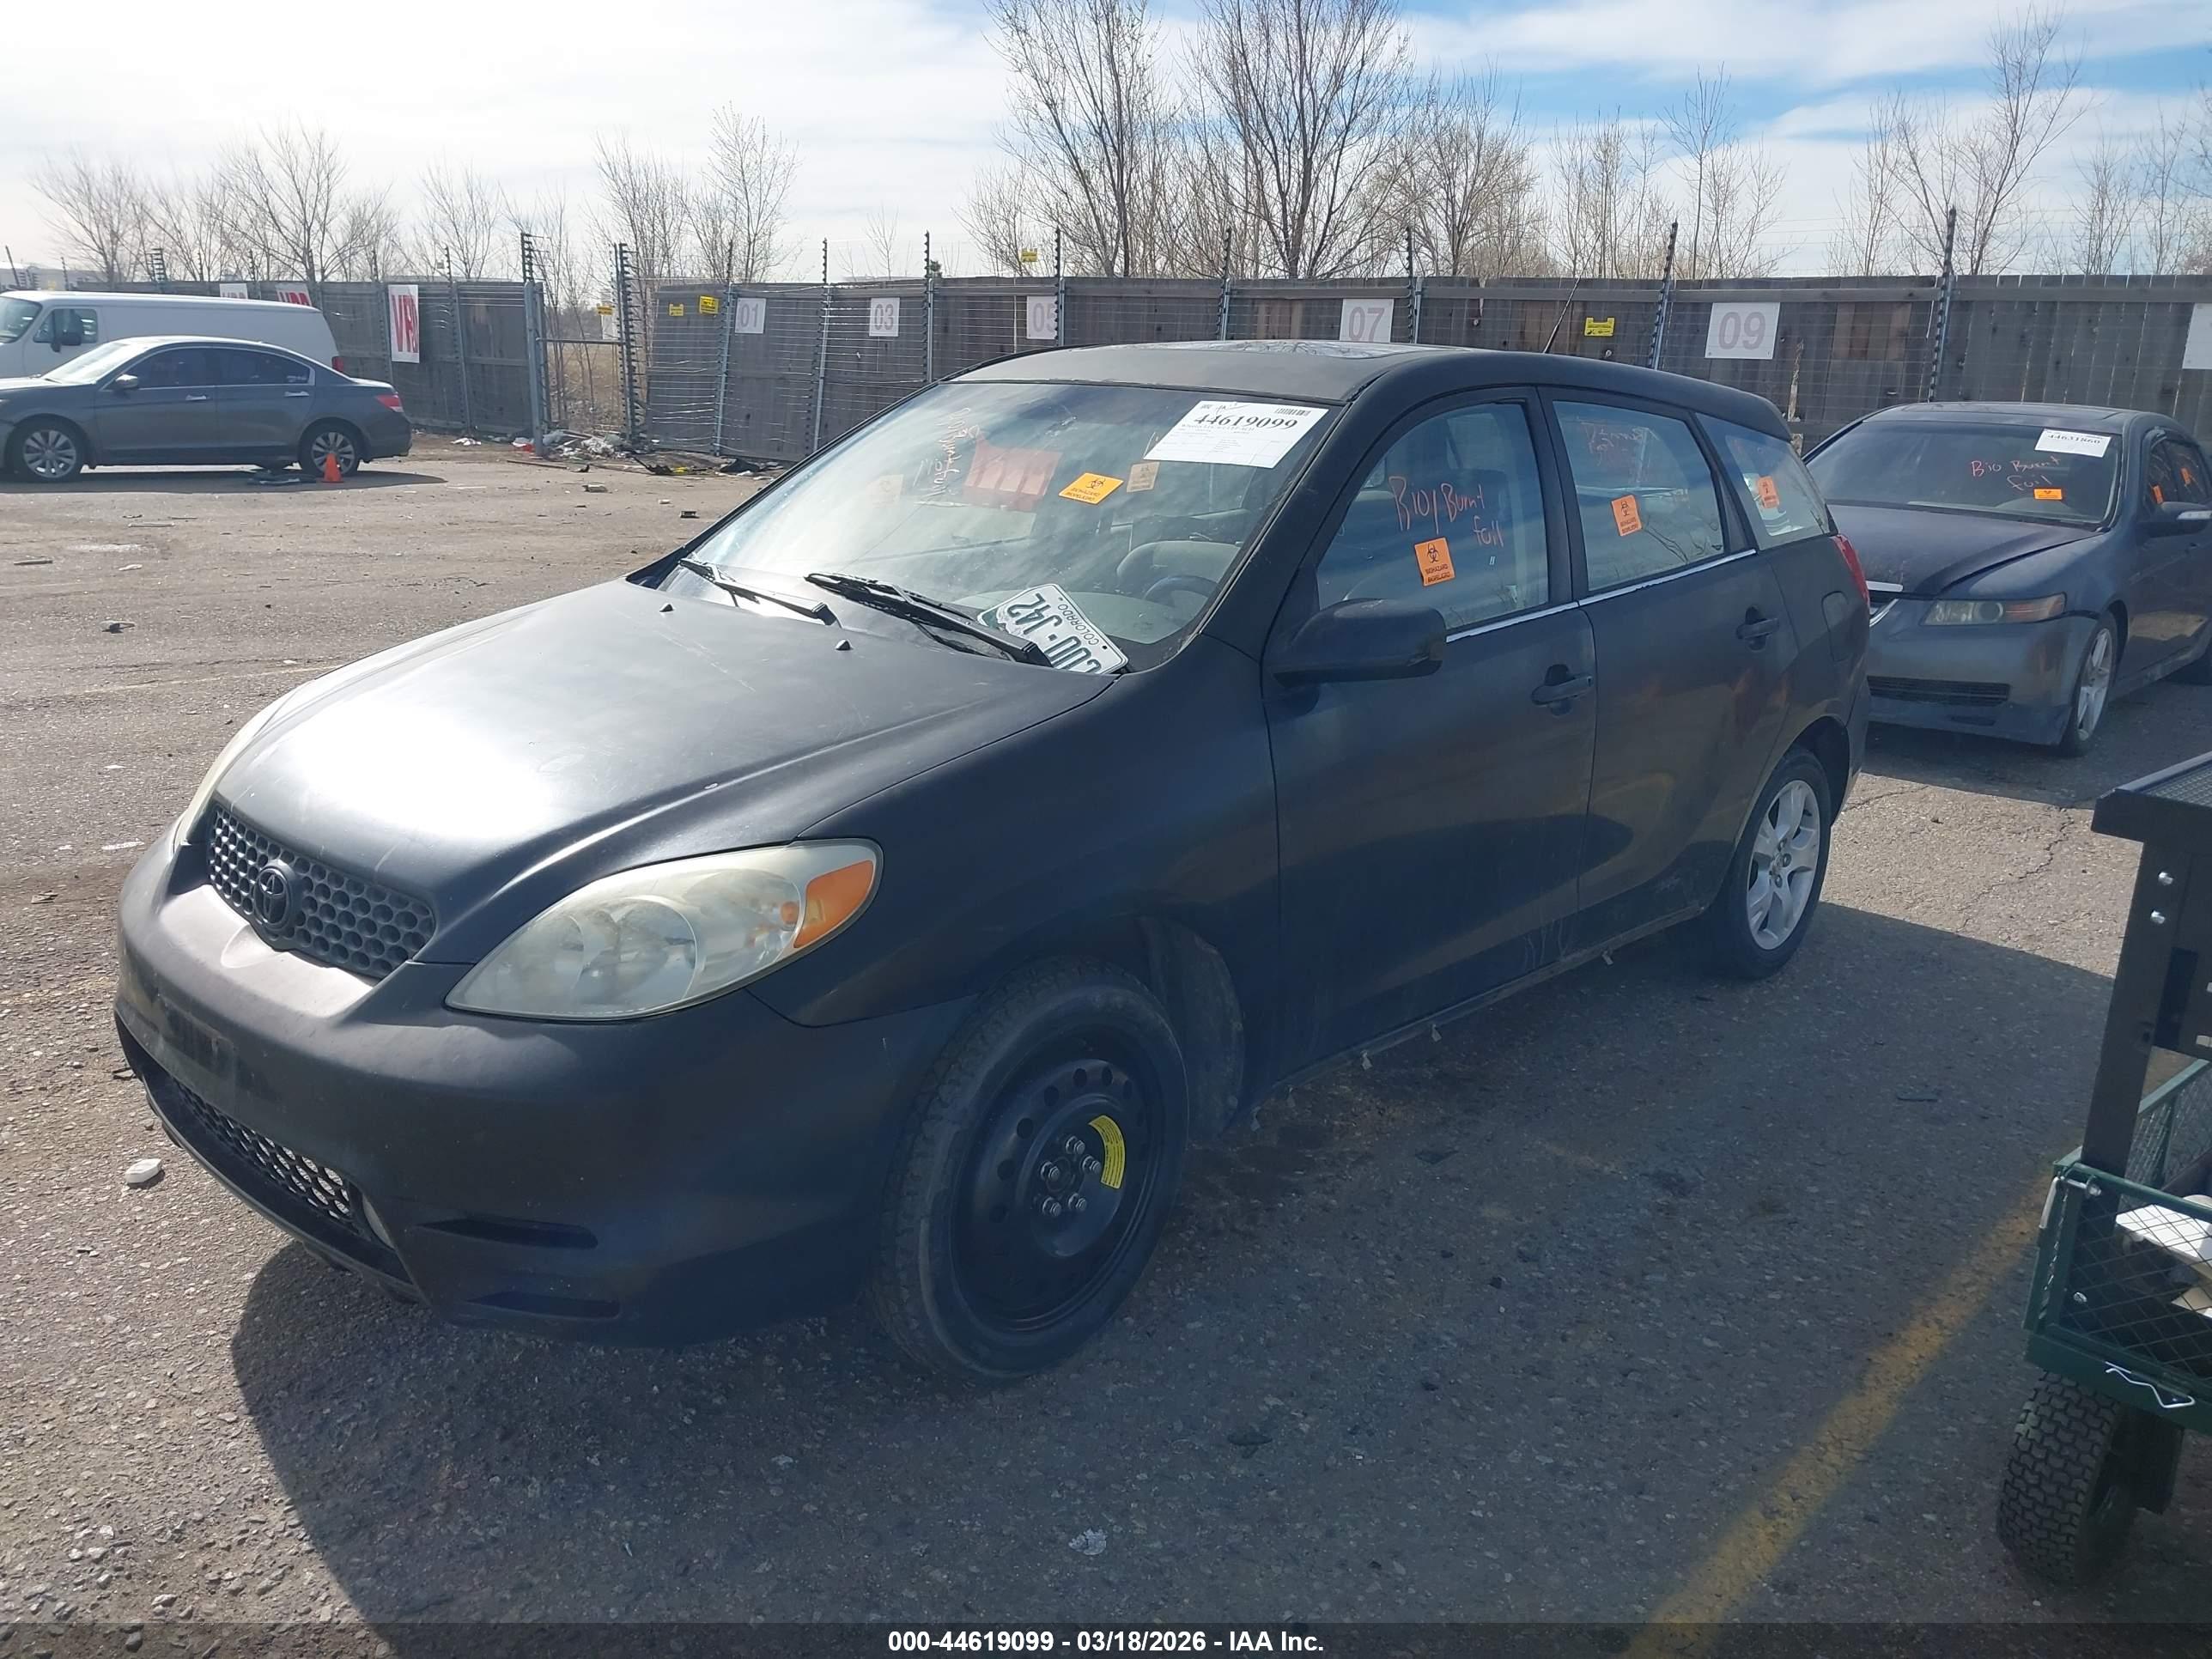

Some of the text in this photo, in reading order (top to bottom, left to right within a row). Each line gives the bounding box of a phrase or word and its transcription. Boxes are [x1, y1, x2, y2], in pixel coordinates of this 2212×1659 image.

[739, 303, 759, 328] 01
[874, 303, 895, 331] 03
[1349, 307, 1385, 343] 07
[1718, 311, 1766, 351] 09
[1194, 413, 1298, 430] 44619099
[1056, 604, 1100, 646] COLORADO
